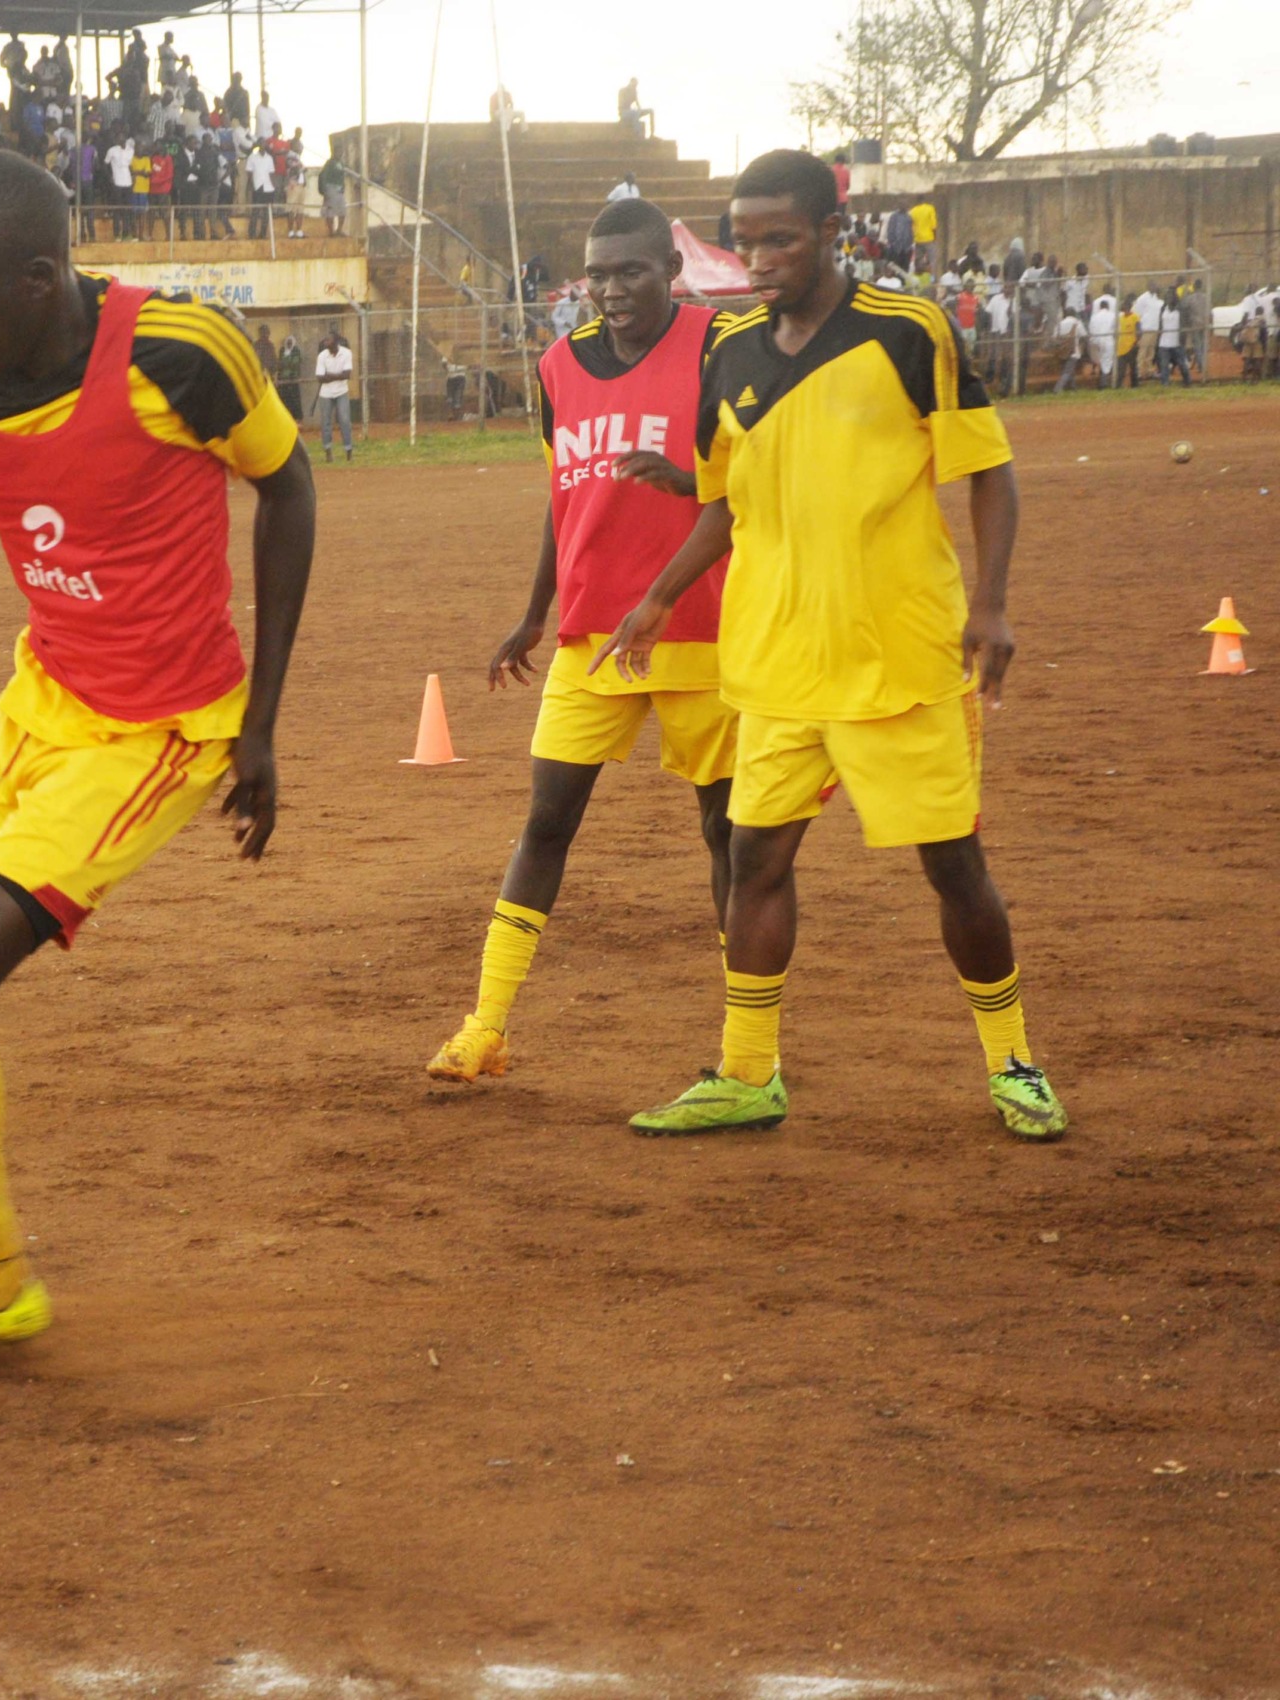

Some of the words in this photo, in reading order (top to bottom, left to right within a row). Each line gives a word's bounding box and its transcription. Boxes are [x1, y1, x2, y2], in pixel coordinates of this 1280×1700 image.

[224, 284, 253, 304] FAIR
[555, 413, 669, 468] NILE
[21, 558, 103, 602] airtel
